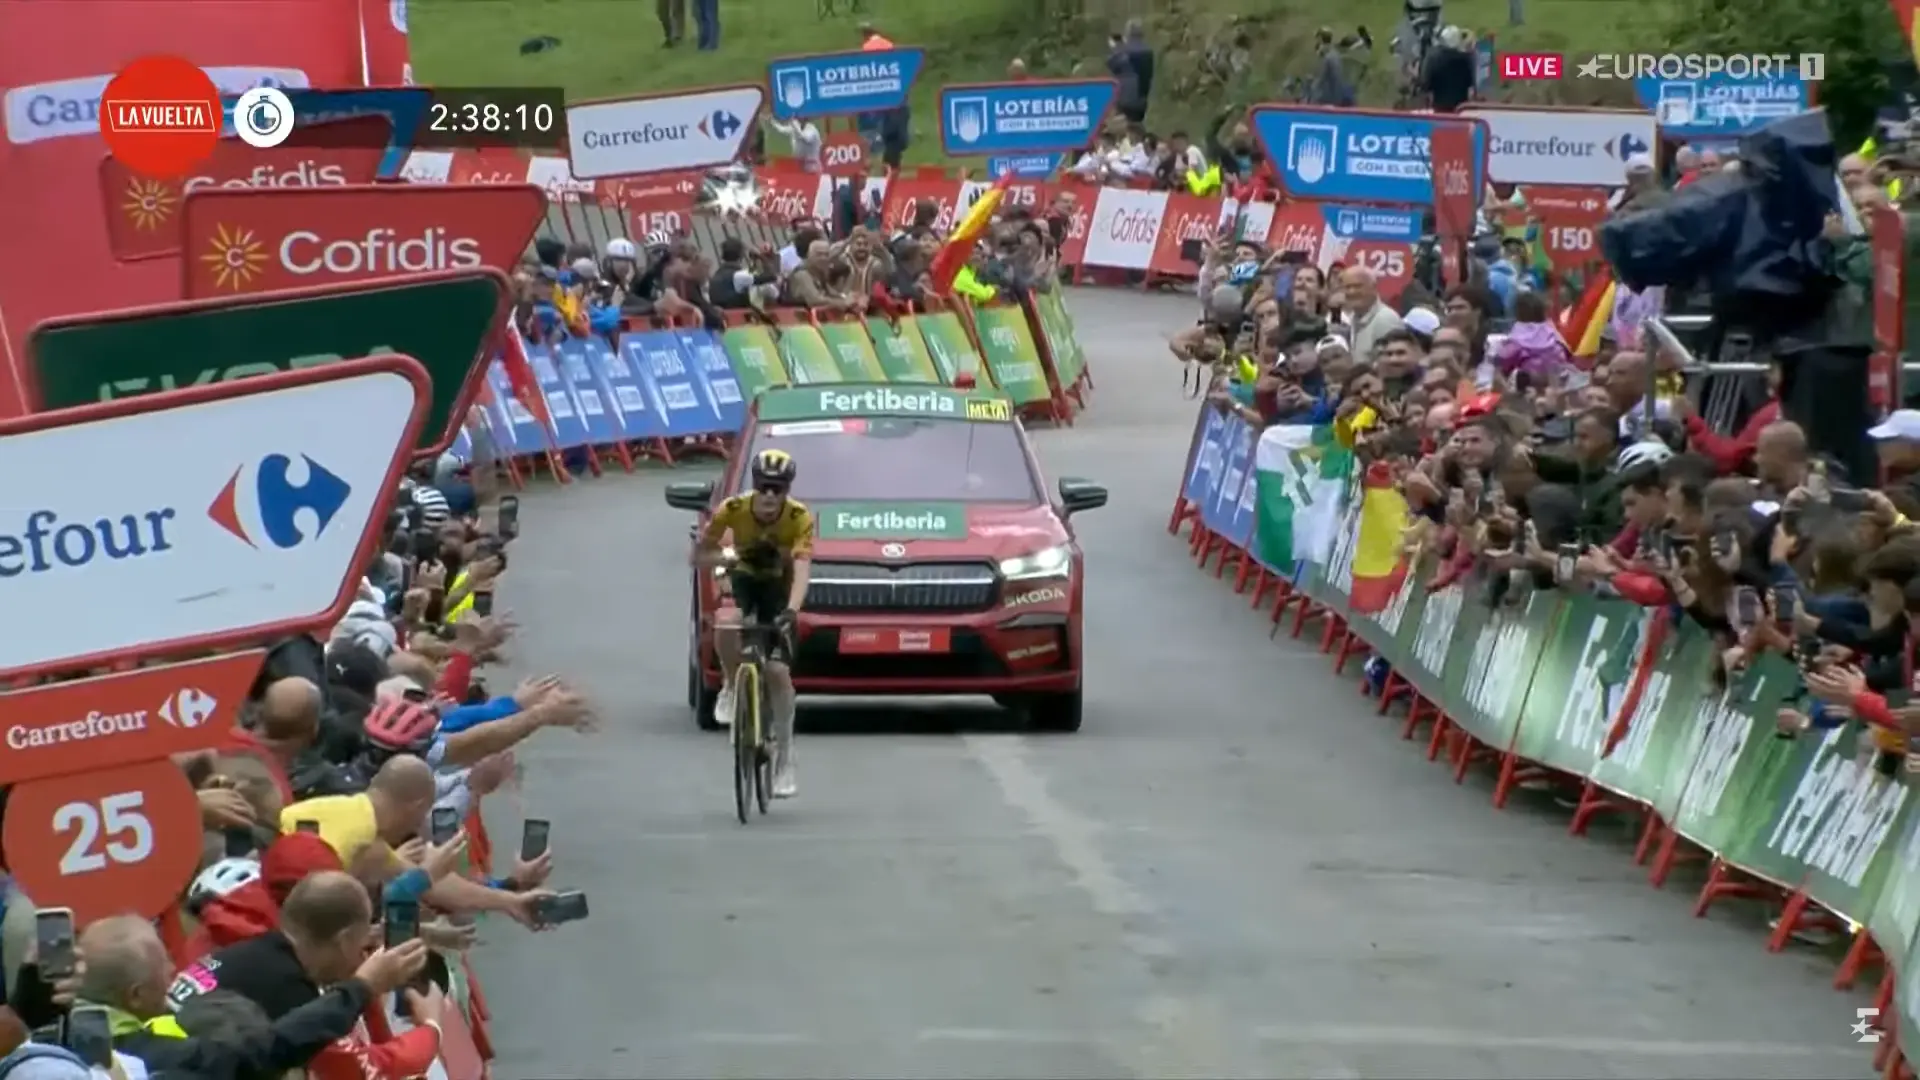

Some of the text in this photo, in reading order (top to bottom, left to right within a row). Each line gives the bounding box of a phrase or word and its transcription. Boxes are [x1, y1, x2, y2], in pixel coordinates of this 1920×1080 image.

[994, 95, 1088, 116] LOTERÍAS
[583, 123, 689, 150] Carrefour
[1347, 132, 1431, 156] LOTER
[1489, 136, 1596, 157] Carrefour
[825, 144, 861, 166] 200
[1110, 208, 1156, 244] Cofidis
[1549, 226, 1593, 251] 150
[279, 227, 482, 275] Cofidis
[1355, 249, 1405, 278] 125
[819, 390, 955, 413] Fertiberia
[836, 511, 946, 531] Fertiberia
[6, 709, 148, 749] Carrefour
[52, 791, 154, 876] 25
